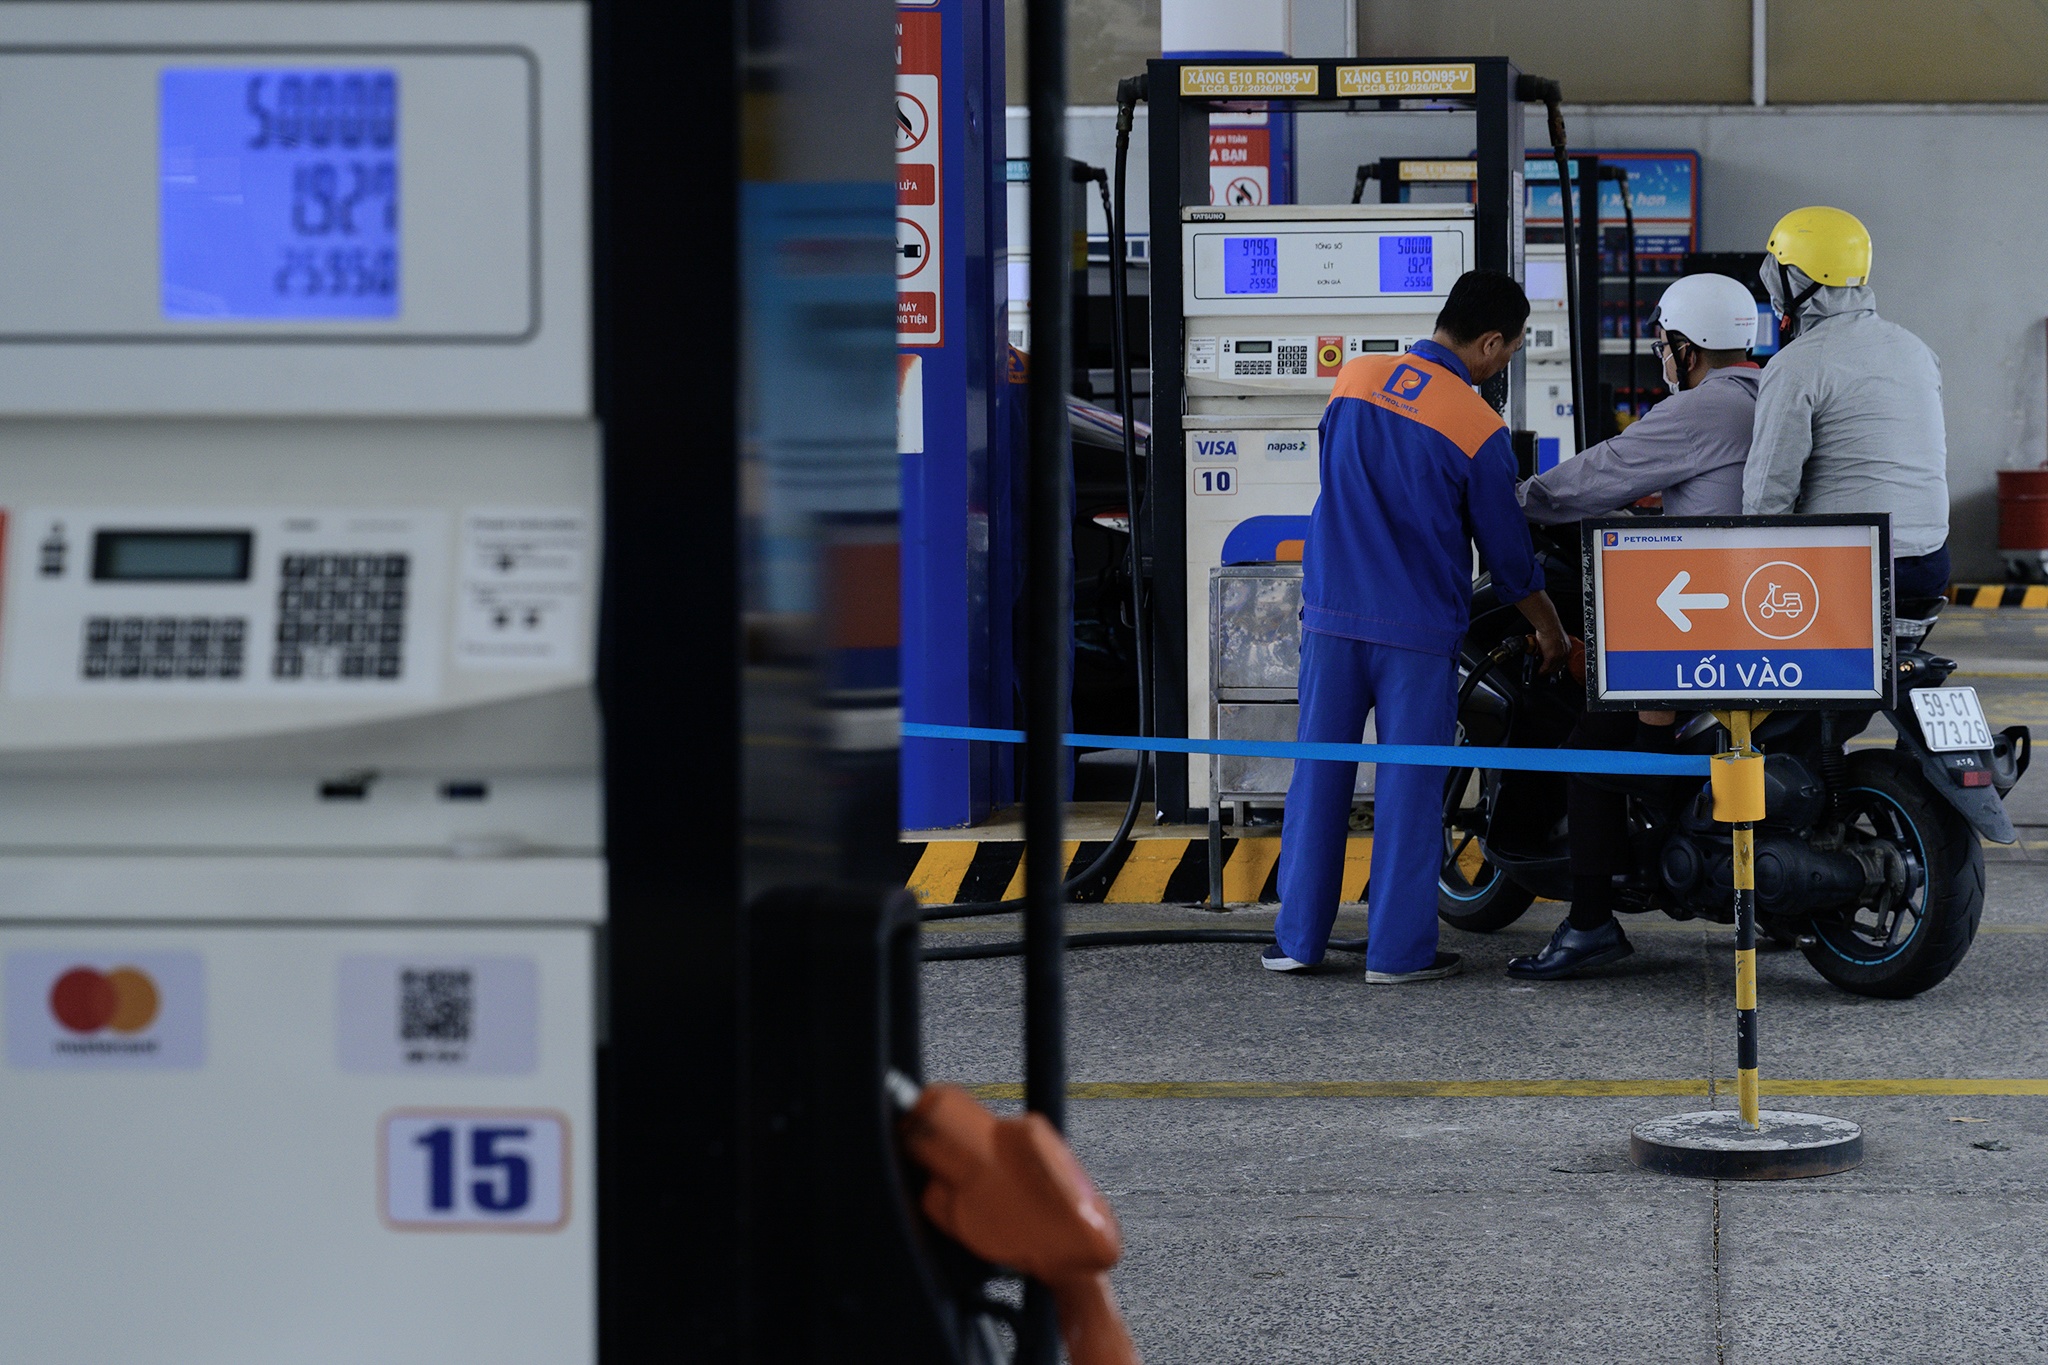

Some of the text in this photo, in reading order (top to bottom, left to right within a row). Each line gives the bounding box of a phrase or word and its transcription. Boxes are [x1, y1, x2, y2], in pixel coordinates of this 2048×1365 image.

[1187, 68, 1312, 84] XĂNG E10 RON95-V
[1344, 68, 1469, 85] XĂNG E10 RON95-V
[1199, 84, 1230, 93] TCCS
[1356, 84, 1386, 93] TCCS
[1220, 148, 1248, 165] BẠN
[899, 178, 918, 191] LỬA
[1191, 213, 1225, 221] TATSUNO
[1243, 239, 1278, 256] 97961
[1397, 237, 1432, 254] 50000
[1323, 260, 1334, 270] LÍT
[1249, 277, 1277, 289] 25950
[1404, 276, 1432, 288] 25950
[898, 301, 917, 312] MÁY
[909, 312, 928, 326] TIỆN
[1372, 391, 1419, 414] PETROLIMEX
[1195, 440, 1298, 455] VISA napas
[1202, 471, 1230, 491] 10
[1623, 535, 1683, 543] PETROLIMEX
[1676, 654, 1803, 688] LỐI VÀO
[1925, 720, 1987, 746] 773.26
[414, 1126, 531, 1215] 15
